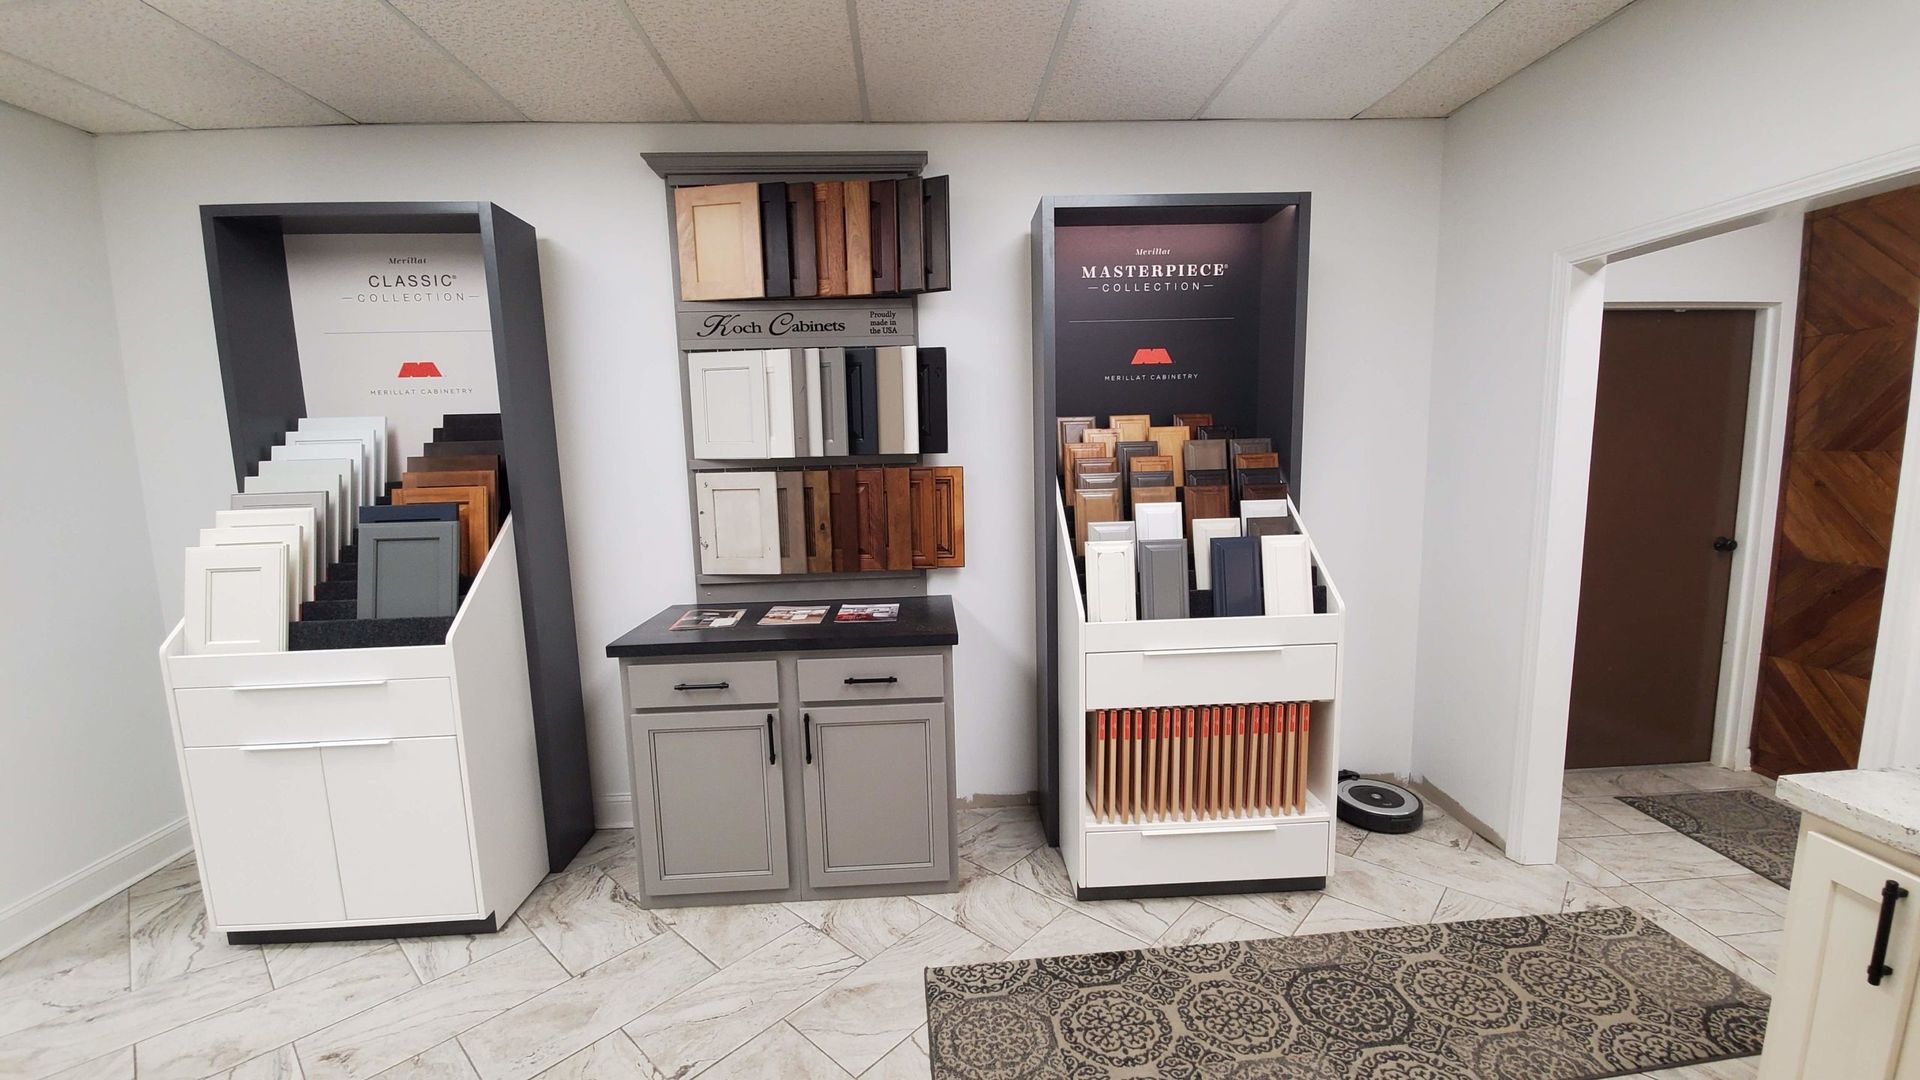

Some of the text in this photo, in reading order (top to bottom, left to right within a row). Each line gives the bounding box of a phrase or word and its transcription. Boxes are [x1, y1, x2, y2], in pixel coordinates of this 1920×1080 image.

[1102, 282, 1200, 292] COLLECTION
[357, 293, 464, 302] COLLECTION
[869, 311, 896, 319] Proudly
[697, 312, 846, 337] Koch Cabinets
[883, 326, 898, 334] USA
